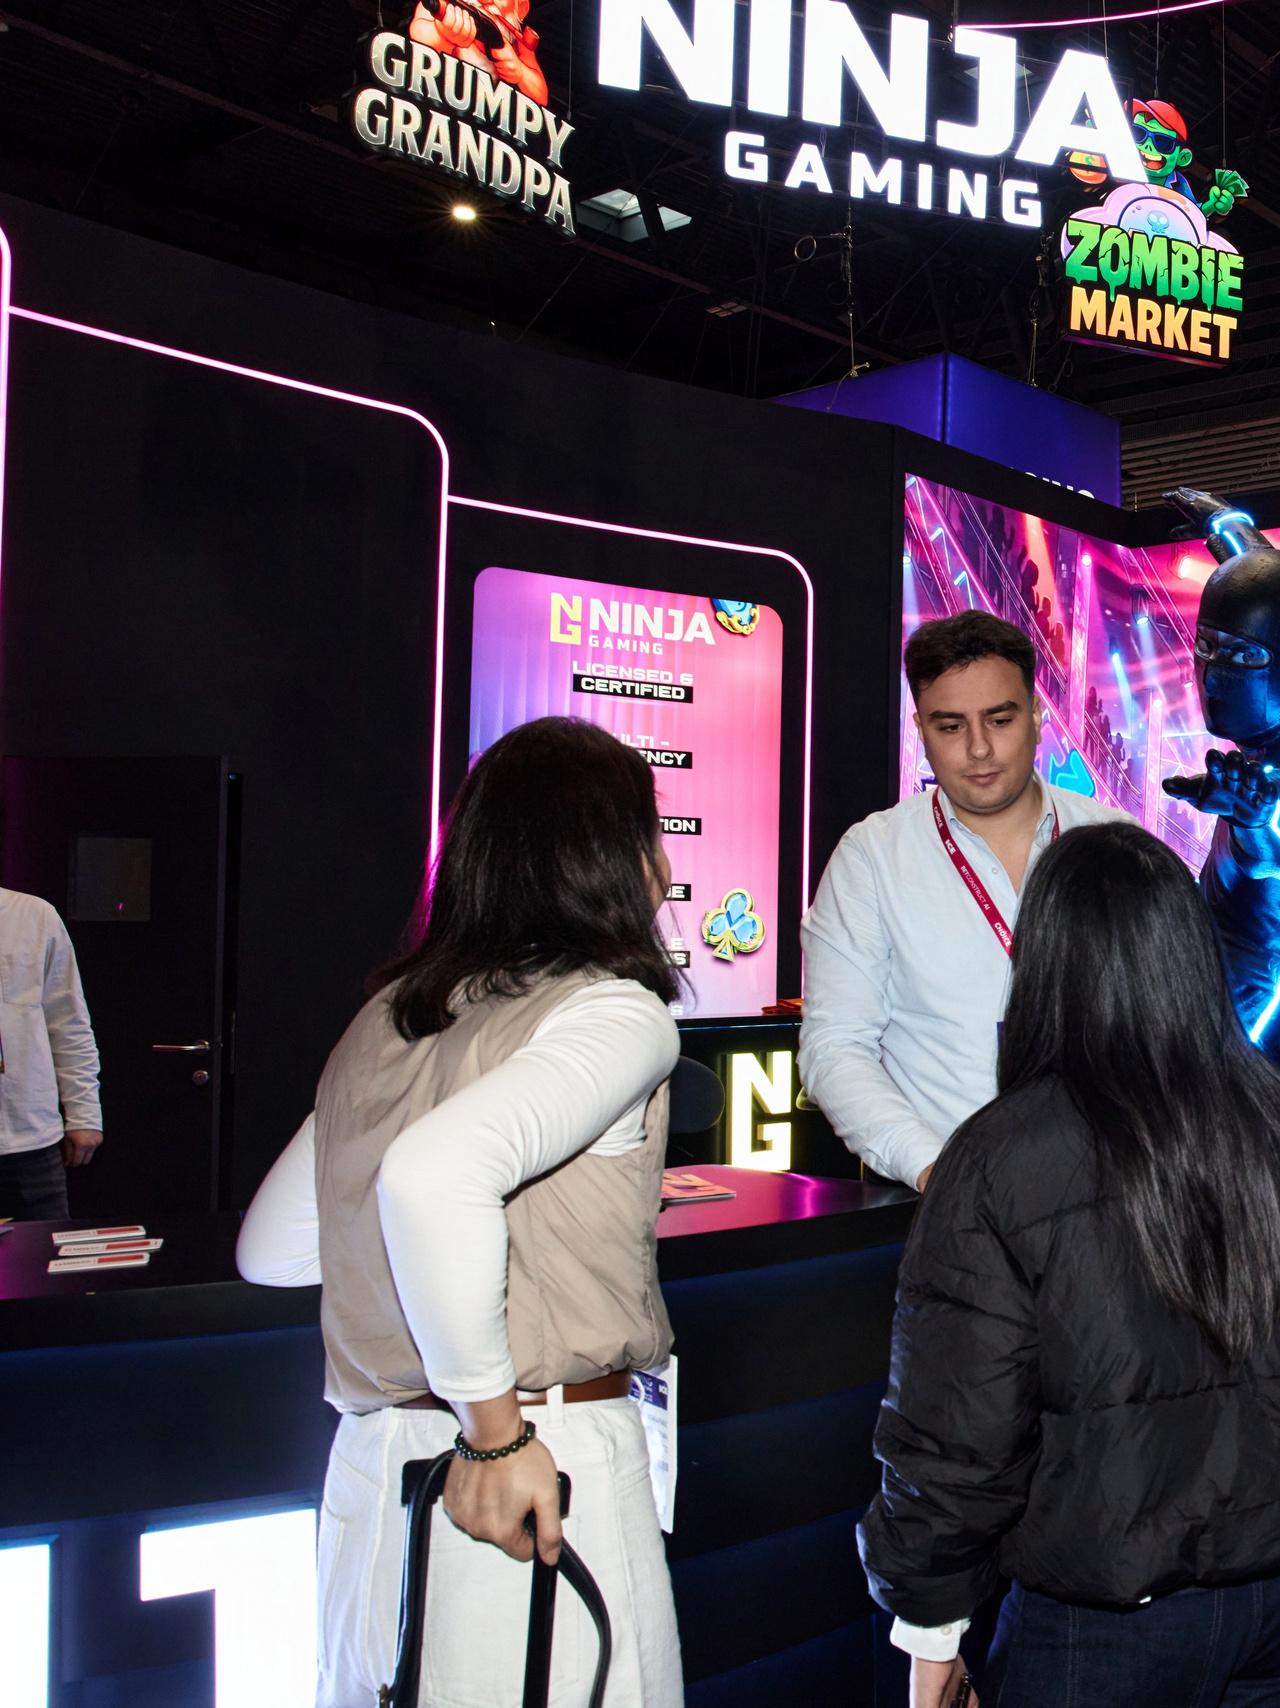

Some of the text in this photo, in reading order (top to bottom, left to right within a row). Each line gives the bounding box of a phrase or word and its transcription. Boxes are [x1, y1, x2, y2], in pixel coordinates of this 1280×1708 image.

[370, 31, 575, 169] GRUMPY
[598, 0, 1148, 183] NINJA
[354, 87, 576, 235] GRANDPA
[724, 130, 1042, 229] GAMING
[1064, 219, 1244, 312] ZOMBIE
[1070, 286, 1238, 359] MARKET
[588, 634, 663, 656] GAMING
[589, 597, 716, 645] NINJA
[572, 660, 694, 686] LICENSED &
[580, 677, 686, 701] CERTIFIED
[945, 839, 957, 855] ICE
